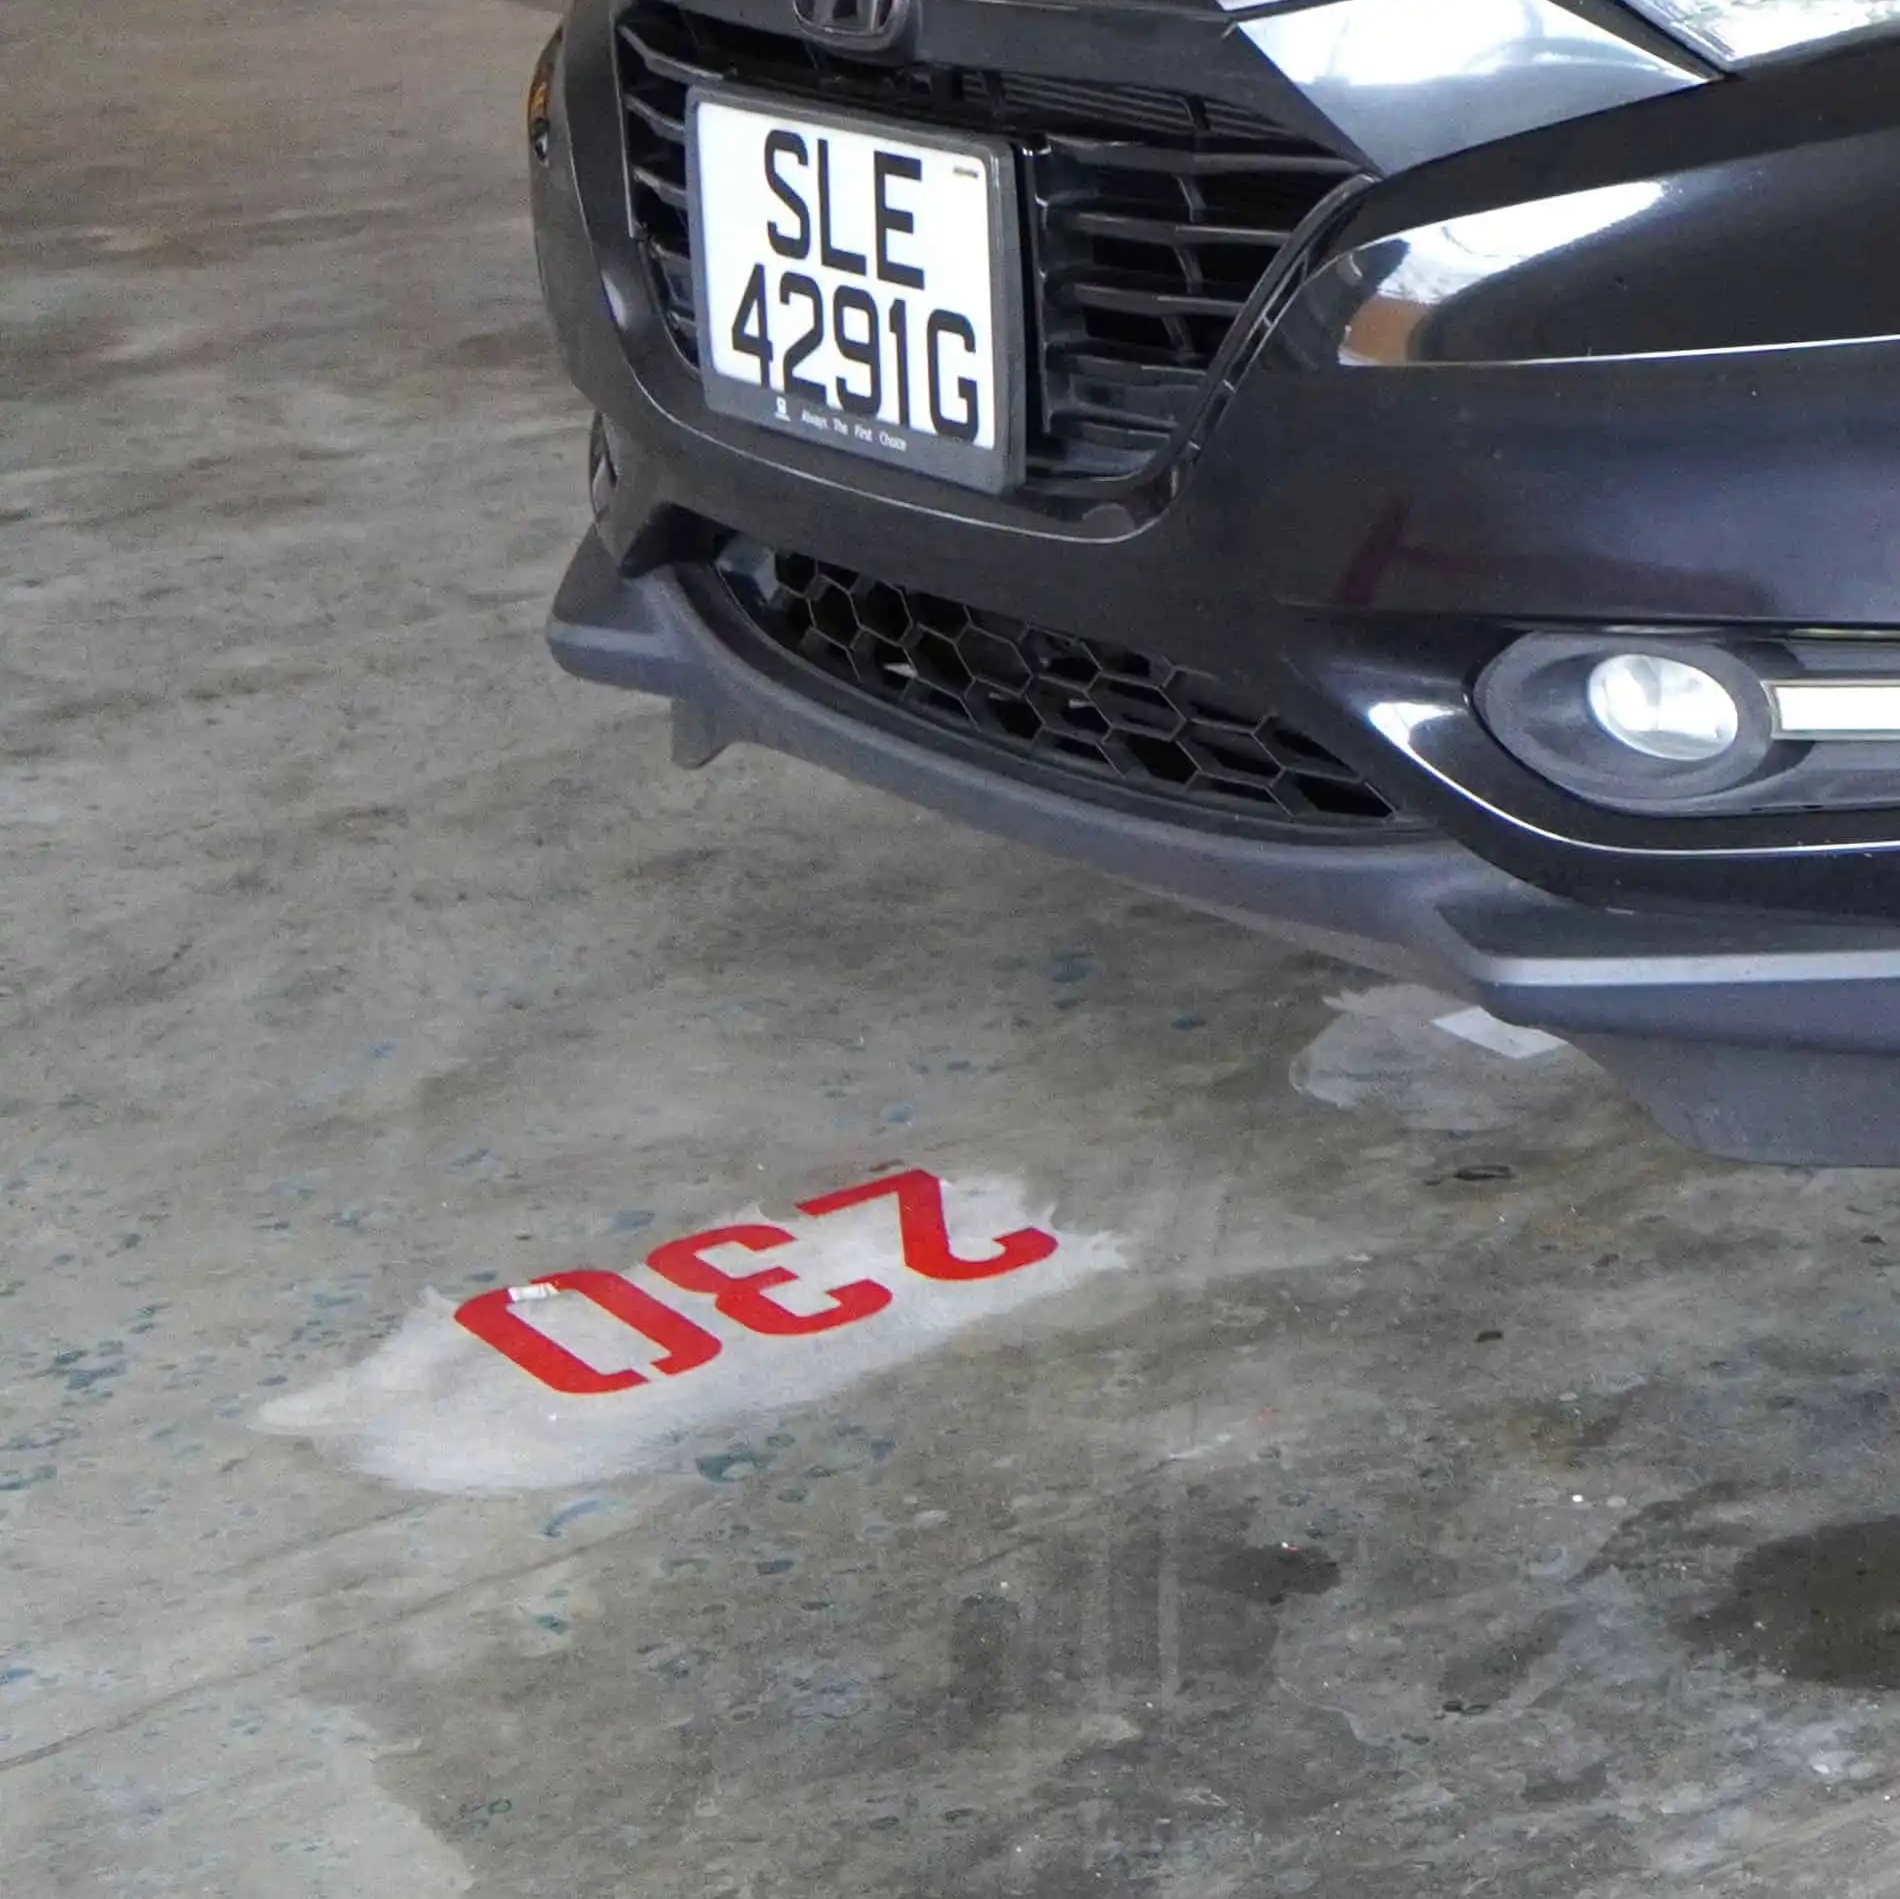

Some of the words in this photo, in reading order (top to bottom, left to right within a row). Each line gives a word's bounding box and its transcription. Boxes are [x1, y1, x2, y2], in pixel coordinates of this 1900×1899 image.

[763, 129, 926, 290] SLE
[731, 263, 979, 446] 4291G
[833, 418, 848, 435] The
[854, 425, 872, 442] First
[880, 431, 907, 452] Choice
[453, 1169, 1058, 1394] 230
